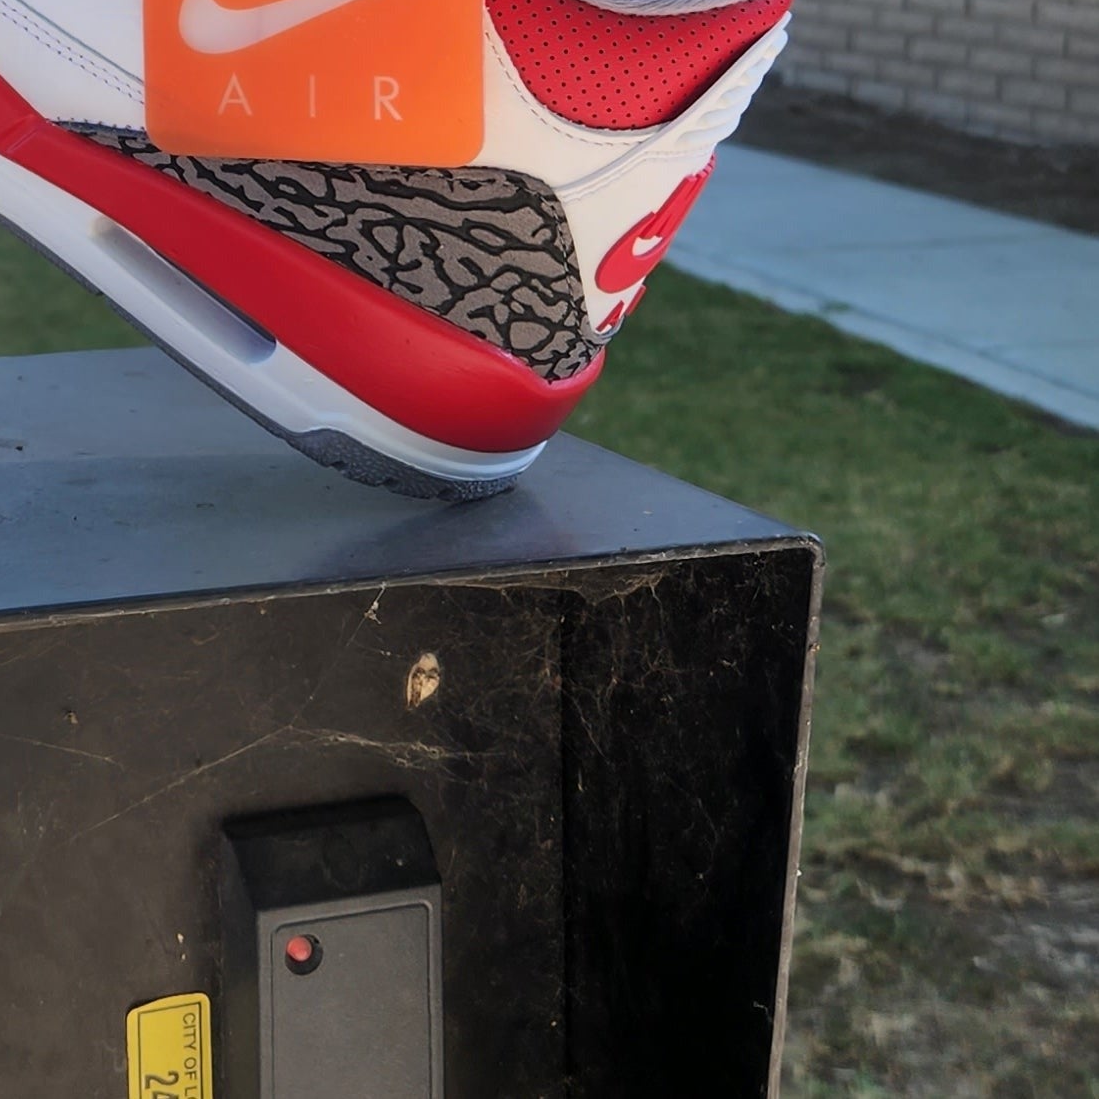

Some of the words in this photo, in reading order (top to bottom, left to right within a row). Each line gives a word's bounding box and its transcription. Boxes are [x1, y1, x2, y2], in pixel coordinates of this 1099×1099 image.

[217, 72, 403, 121] AIR
[183, 1012, 197, 1051] CITY
[184, 1057, 198, 1080] OF
[185, 1086, 198, 1099] L
